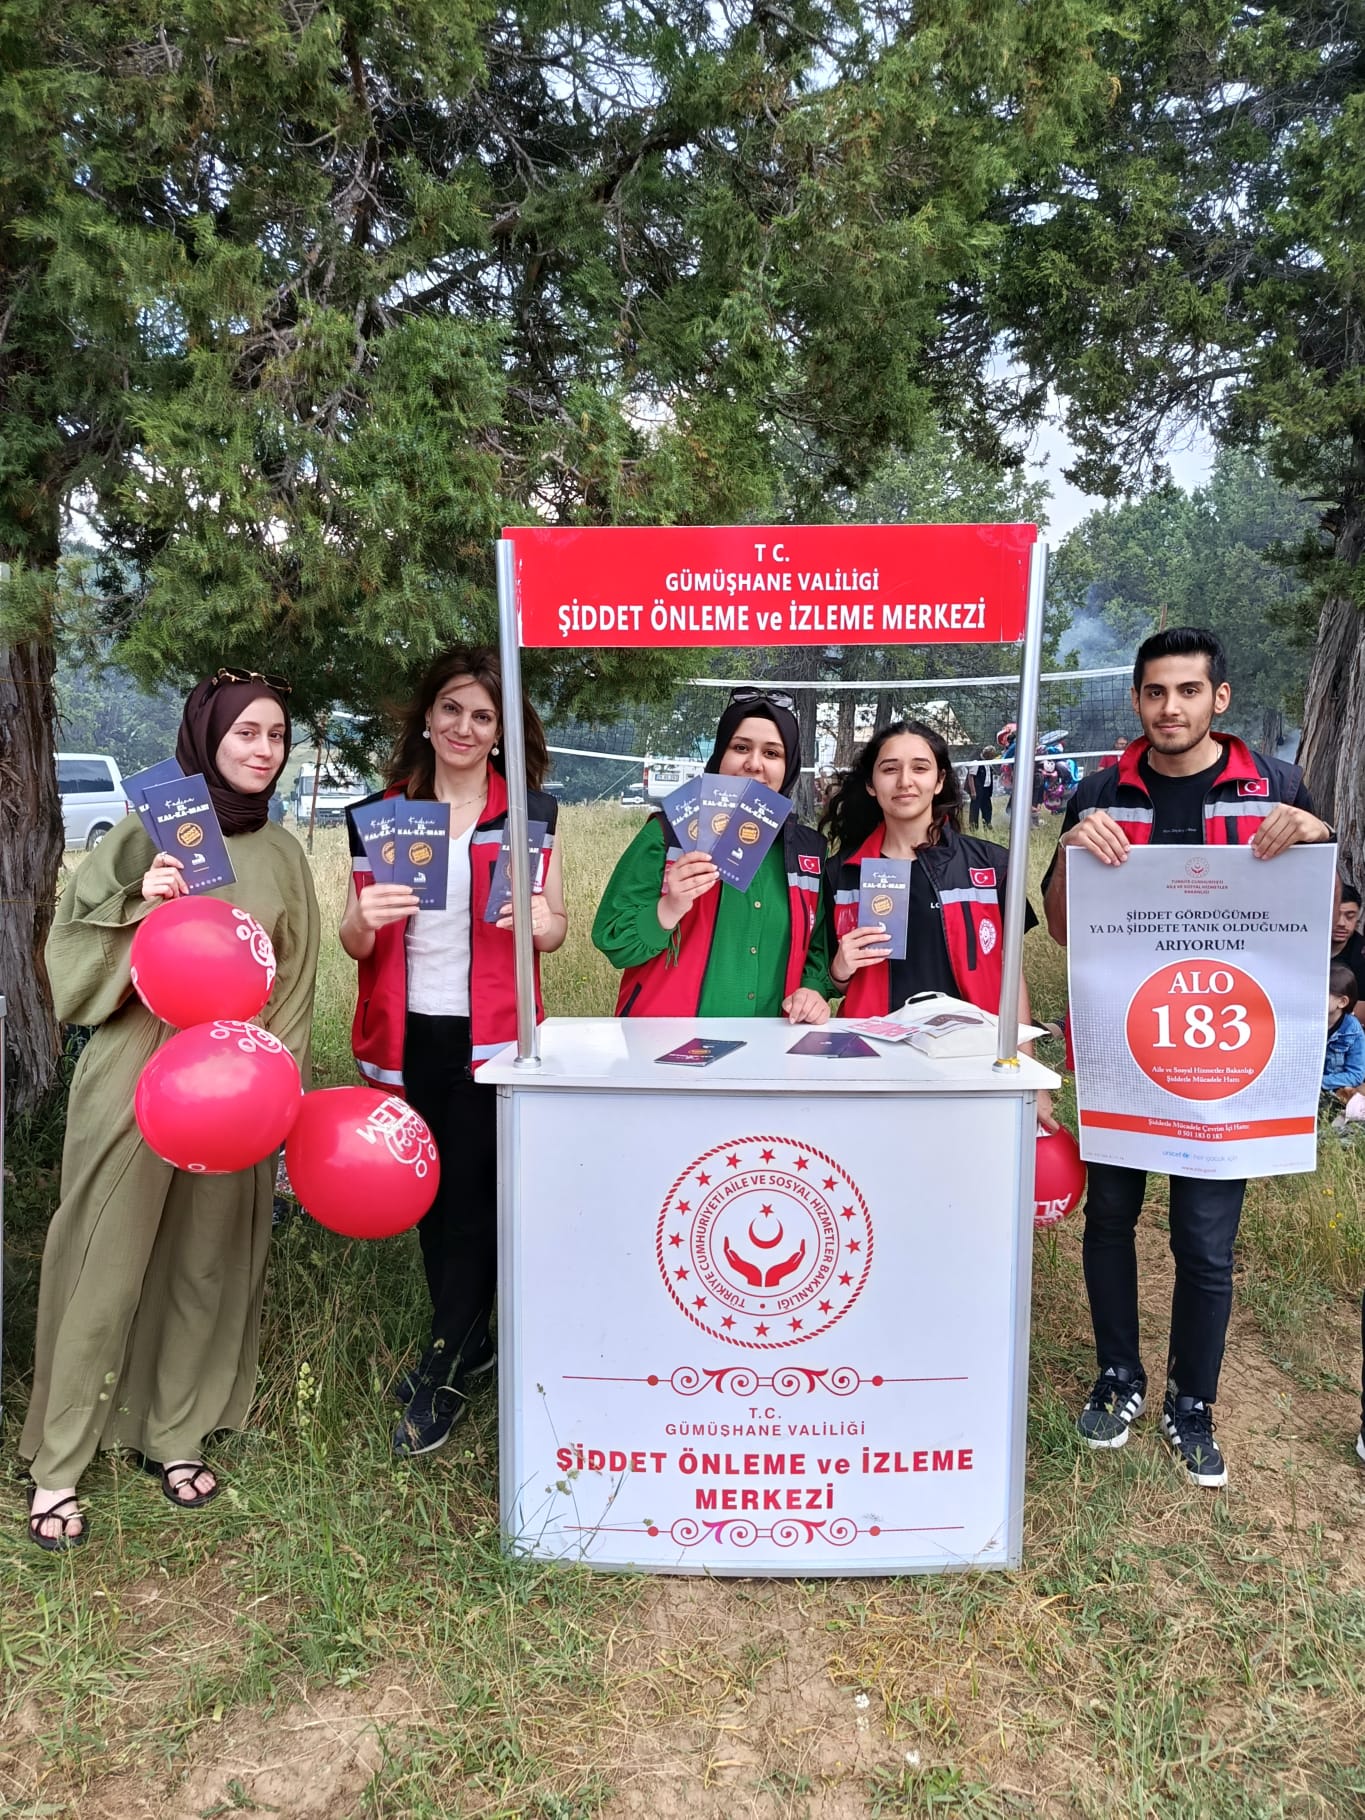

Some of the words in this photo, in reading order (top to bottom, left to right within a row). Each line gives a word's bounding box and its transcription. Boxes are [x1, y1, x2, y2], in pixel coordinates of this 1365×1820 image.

[754, 543, 767, 562] T
[772, 543, 790, 562] C.
[665, 568, 792, 596] GÜMÜŞHANE
[557, 598, 643, 637] ŞİDDET
[649, 598, 749, 632] ÖNLEME
[756, 610, 783, 632] ve
[789, 599, 874, 631] İZLEME
[882, 597, 986, 631] MERKEZİ
[1126, 909, 1173, 922] ŞİDDET
[1175, 909, 1270, 921] GÖRDÜĞÜMDE
[1089, 924, 1104, 934] YA
[1106, 924, 1125, 934] DA
[1127, 922, 1180, 936] ŞİDDETE
[1181, 923, 1219, 933] TANIK
[1222, 921, 1309, 933] OLDUĞUMDA
[1155, 939, 1246, 951] ARIYORUM!
[1168, 970, 1235, 994] ALO
[1151, 1003, 1252, 1051] 183
[1151, 1066, 1164, 1074] Aile
[1173, 1066, 1193, 1076] Sosyal
[725, 1177, 749, 1197] AİLE
[750, 1174, 766, 1185] VE
[769, 1174, 810, 1200] SOSYAL
[695, 1190, 726, 1272] CUMHURİYETİ
[809, 1198, 836, 1269] HİZMETLER
[704, 1271, 746, 1309] TÜRKİYE
[777, 1264, 830, 1310] BAKANLIĞI
[748, 1407, 782, 1420] T.C.
[665, 1420, 782, 1438] GÜMÜŞHANE
[788, 1420, 866, 1437] VALİLİĞİ
[556, 1442, 667, 1476] ŞİDDET
[678, 1447, 806, 1475] ÖNLEME
[817, 1455, 851, 1475] ve
[862, 1446, 974, 1474] İZLEME
[695, 1483, 835, 1510] MERKEZİ
